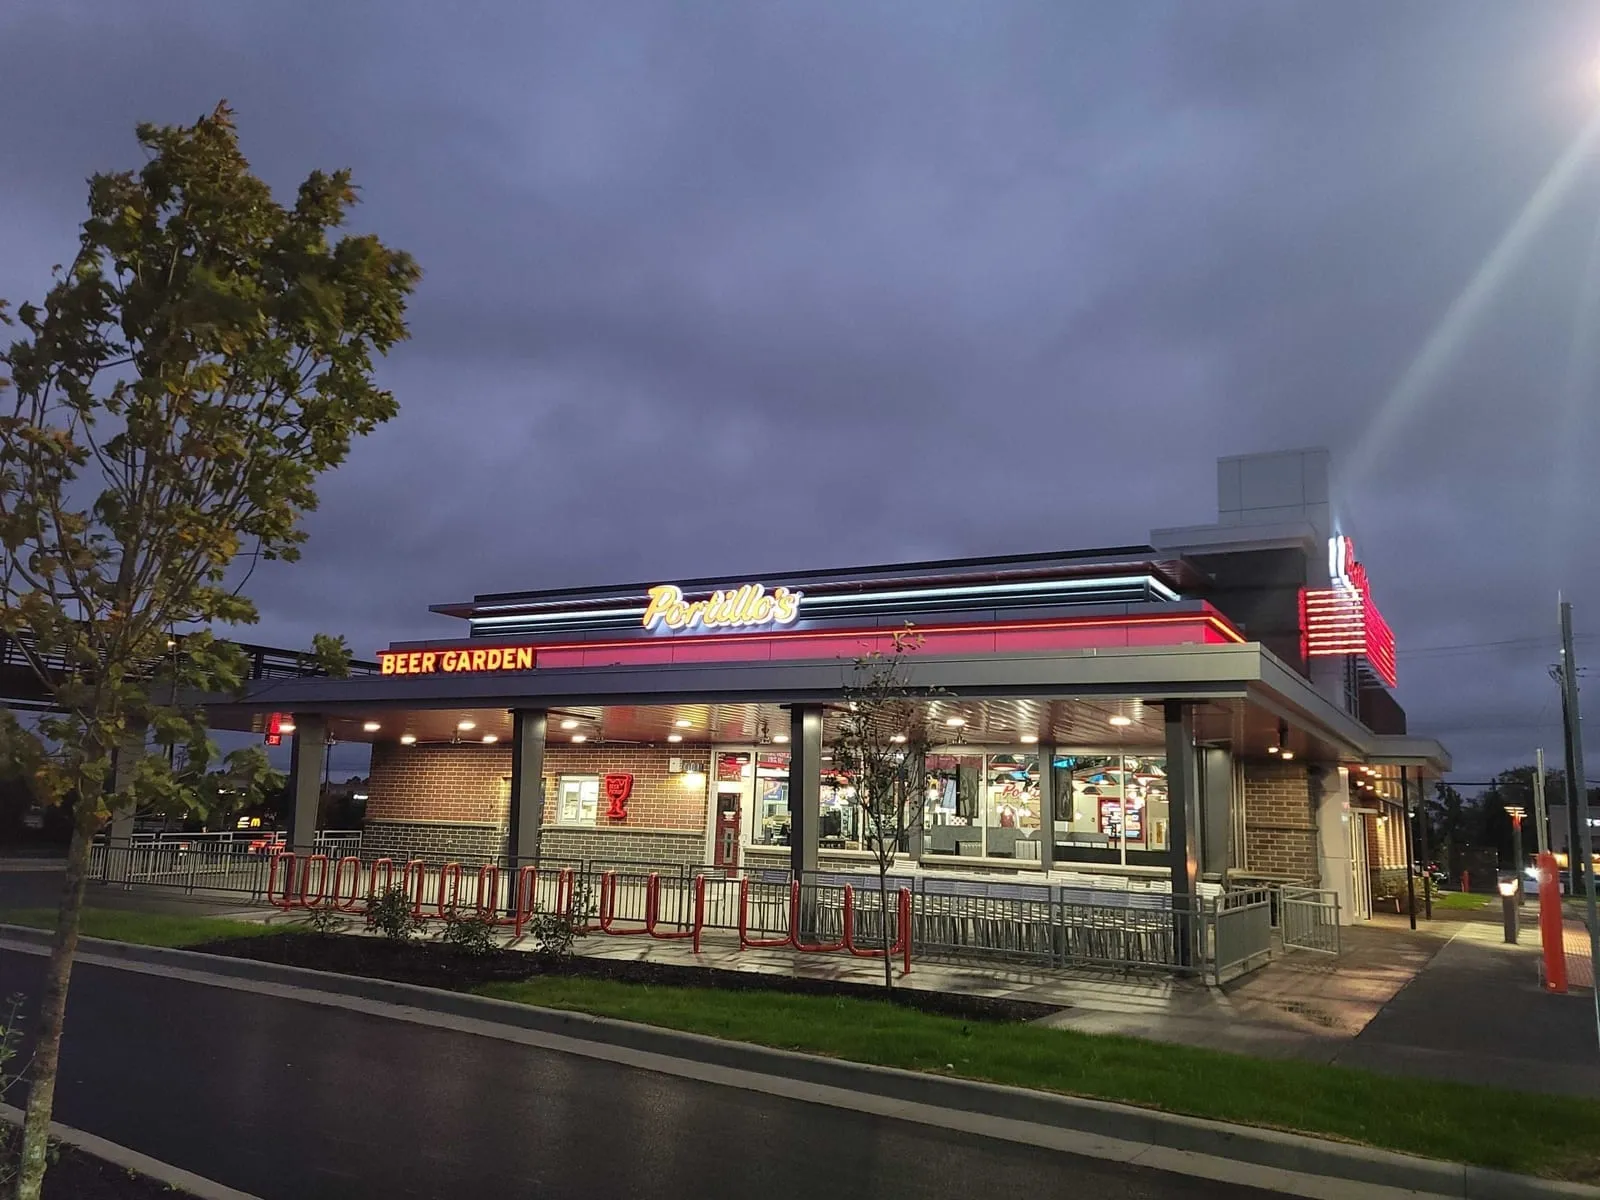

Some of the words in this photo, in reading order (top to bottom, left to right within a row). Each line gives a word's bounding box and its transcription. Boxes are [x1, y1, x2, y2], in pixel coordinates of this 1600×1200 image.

[643, 584, 800, 629] Portillo's
[382, 652, 436, 675] BEER
[442, 647, 533, 673] GARDEN
